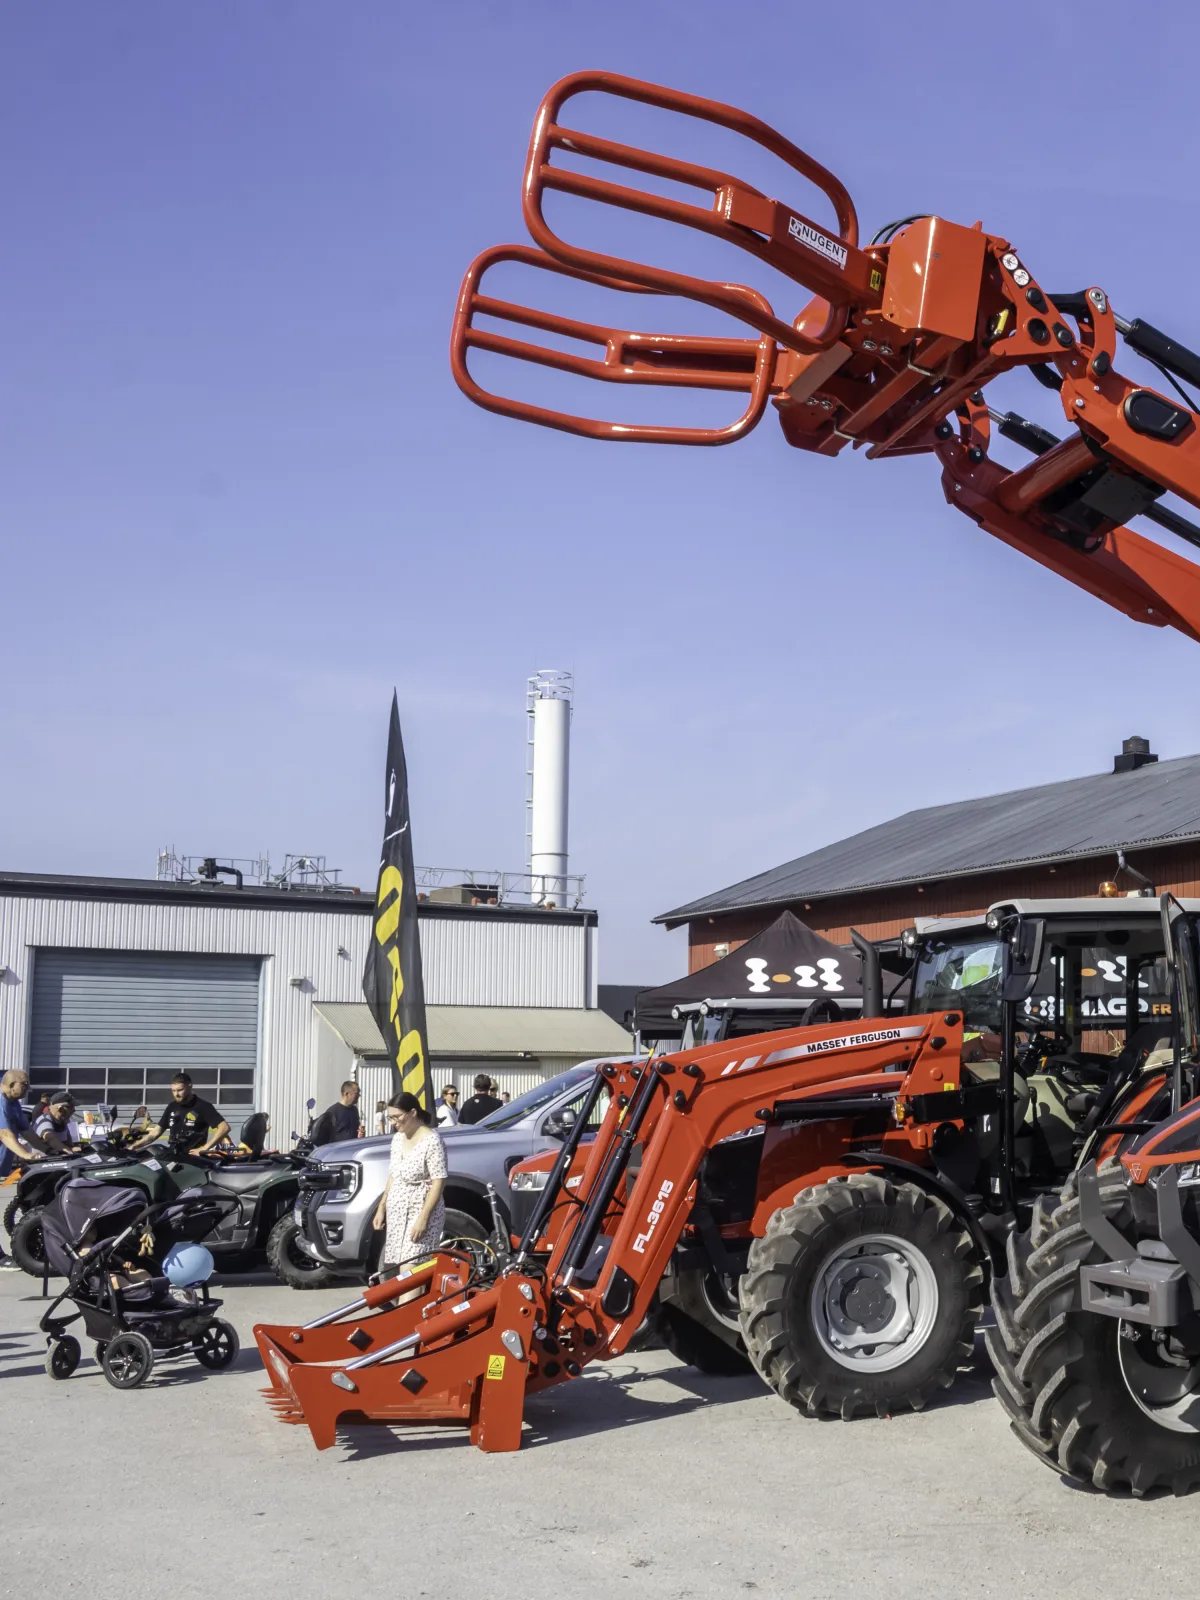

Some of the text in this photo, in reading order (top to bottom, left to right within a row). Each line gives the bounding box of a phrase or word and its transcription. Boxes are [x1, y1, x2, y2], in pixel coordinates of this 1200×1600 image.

[802, 225, 847, 259] NUGENT
[807, 1030, 901, 1053] MASSEY FERGUSON
[632, 1179, 674, 1254] FL.3615
